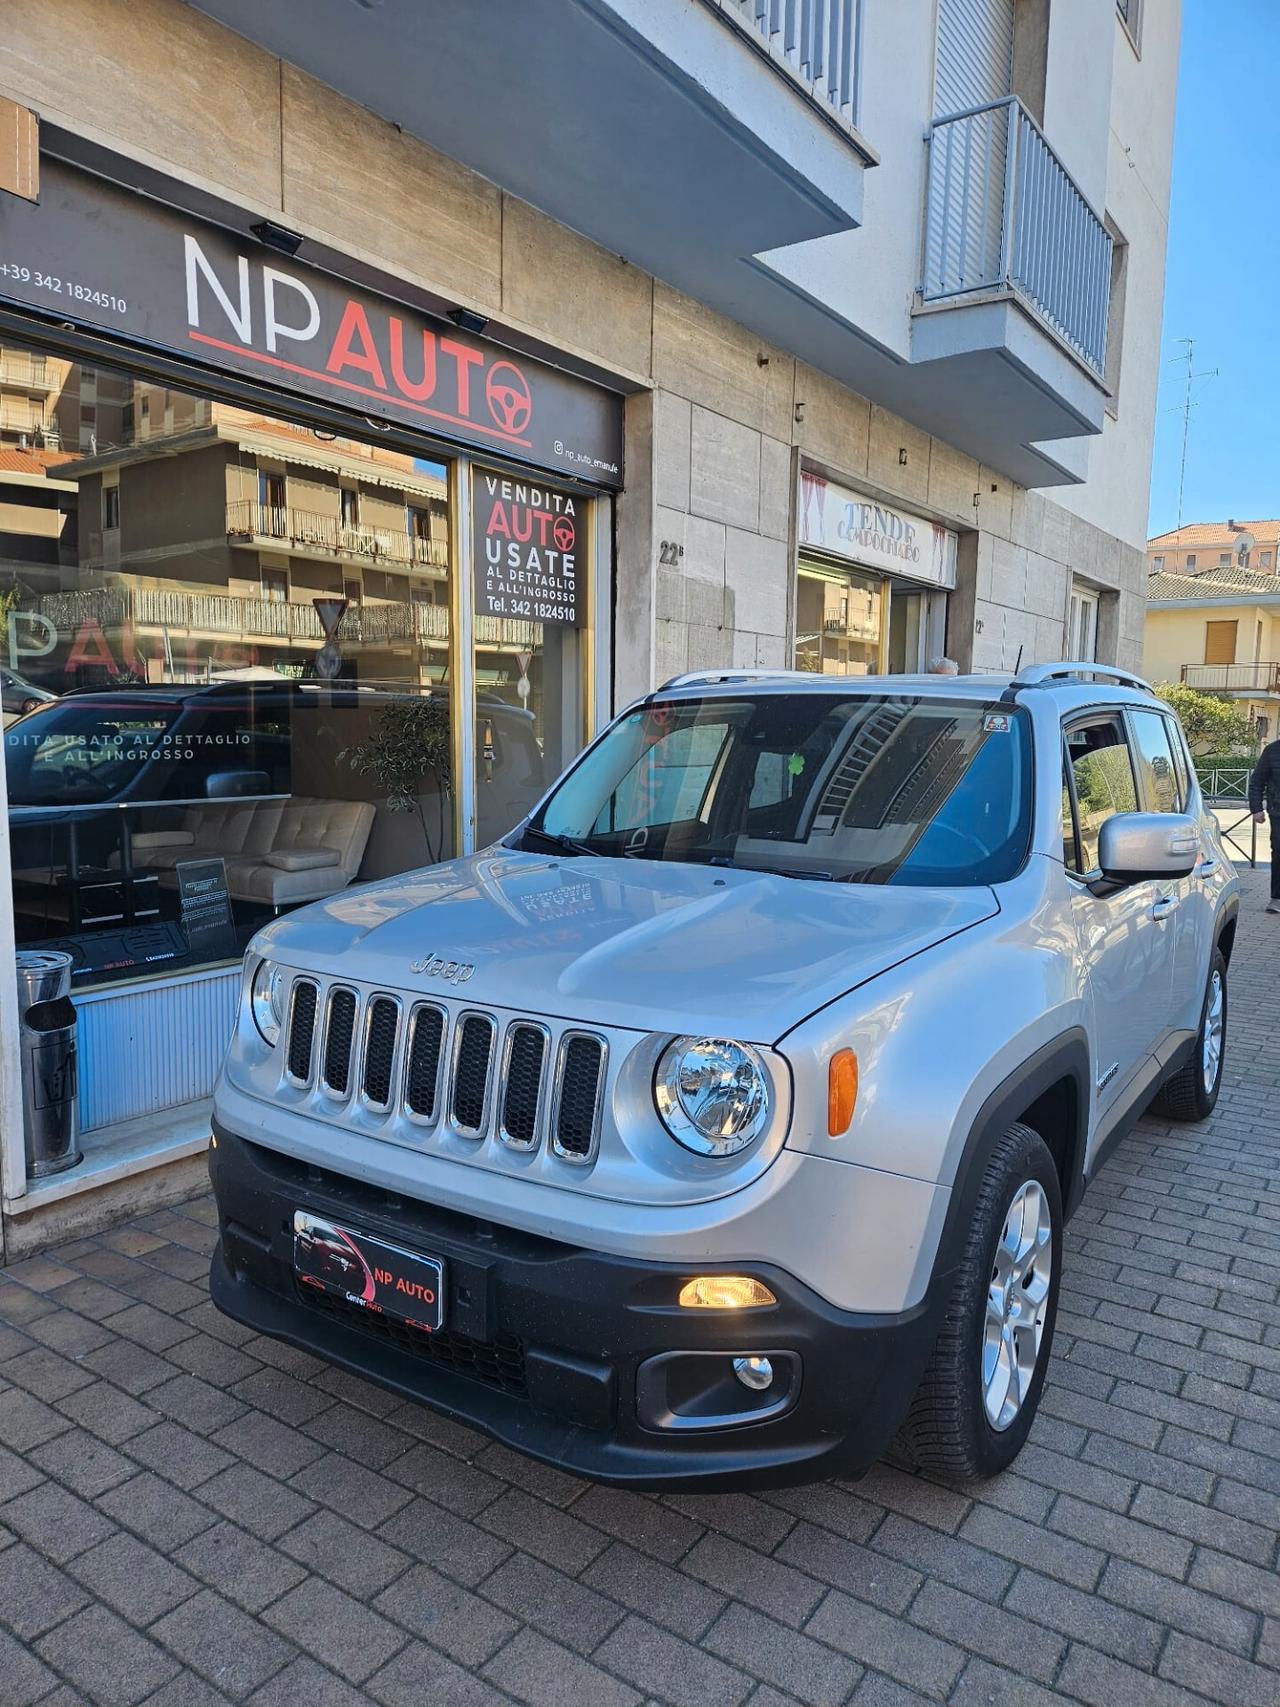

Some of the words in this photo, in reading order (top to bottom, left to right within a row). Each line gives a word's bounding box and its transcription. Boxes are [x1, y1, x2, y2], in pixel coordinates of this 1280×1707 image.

[0, 263, 30, 282] +39
[34, 271, 63, 293] 342
[66, 282, 127, 313] 1824510
[485, 476, 576, 517] VENDITA
[845, 502, 916, 545] TENDE
[485, 537, 576, 578] USATE
[487, 565, 503, 578] AL
[510, 569, 576, 591] DETTAGLIO
[487, 580, 493, 590] E
[498, 582, 576, 603] ALL'INGROSSO
[487, 595, 508, 613] Tel.
[511, 599, 531, 615] 342
[534, 602, 576, 622] 1824510
[45, 751, 54, 762] E
[65, 749, 195, 763] ALL'INGROSSO
[65, 735, 123, 746] USATO
[133, 734, 154, 746] AL
[163, 734, 251, 746] DETTAGLIO
[409, 951, 477, 986] Jeep
[374, 1267, 393, 1286] NP
[396, 1277, 435, 1304] AUTO
